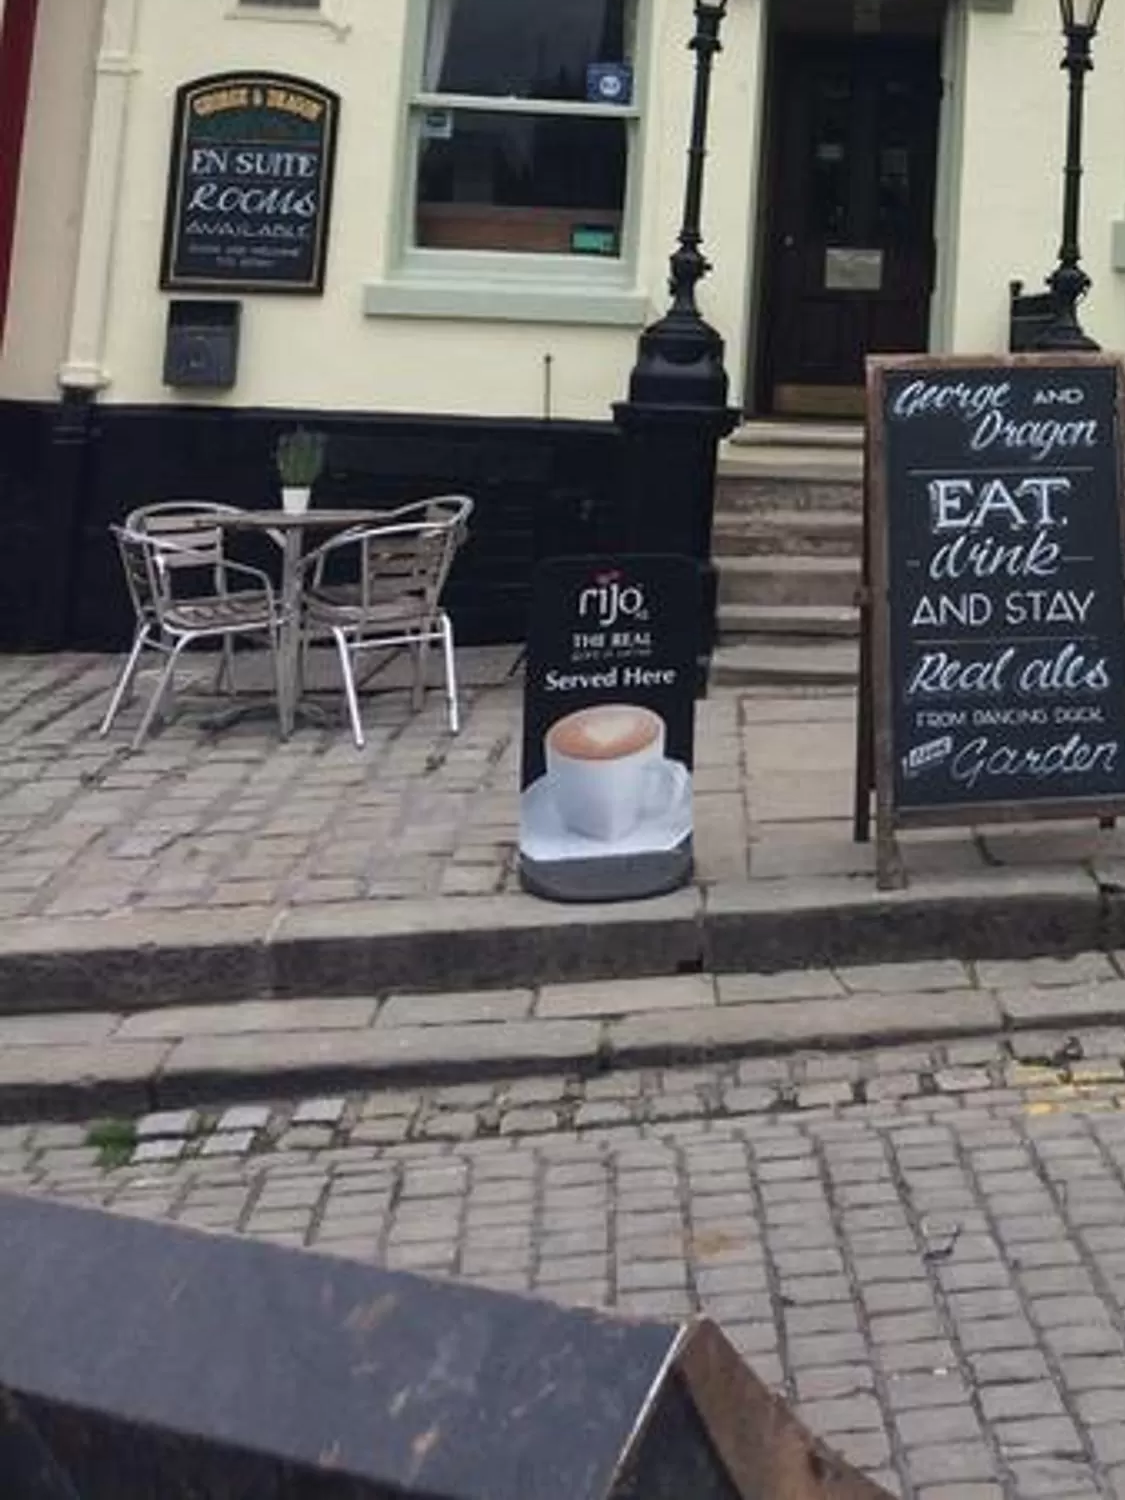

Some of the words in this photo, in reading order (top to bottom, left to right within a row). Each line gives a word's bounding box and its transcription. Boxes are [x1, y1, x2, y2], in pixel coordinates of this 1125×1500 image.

[192, 148, 228, 174] EN
[235, 151, 318, 177] SUITE
[894, 380, 1010, 418] George
[1033, 389, 1084, 405] AND
[971, 410, 1098, 460] Dragon
[929, 530, 1061, 580] drink
[911, 593, 992, 626] AND
[1005, 590, 1095, 623] STAY
[544, 667, 618, 692] Served
[623, 665, 677, 687] Here
[908, 647, 1015, 695] Real
[1020, 643, 1111, 690] ales
[916, 711, 966, 728] FROM
[951, 733, 1119, 788] Garden
